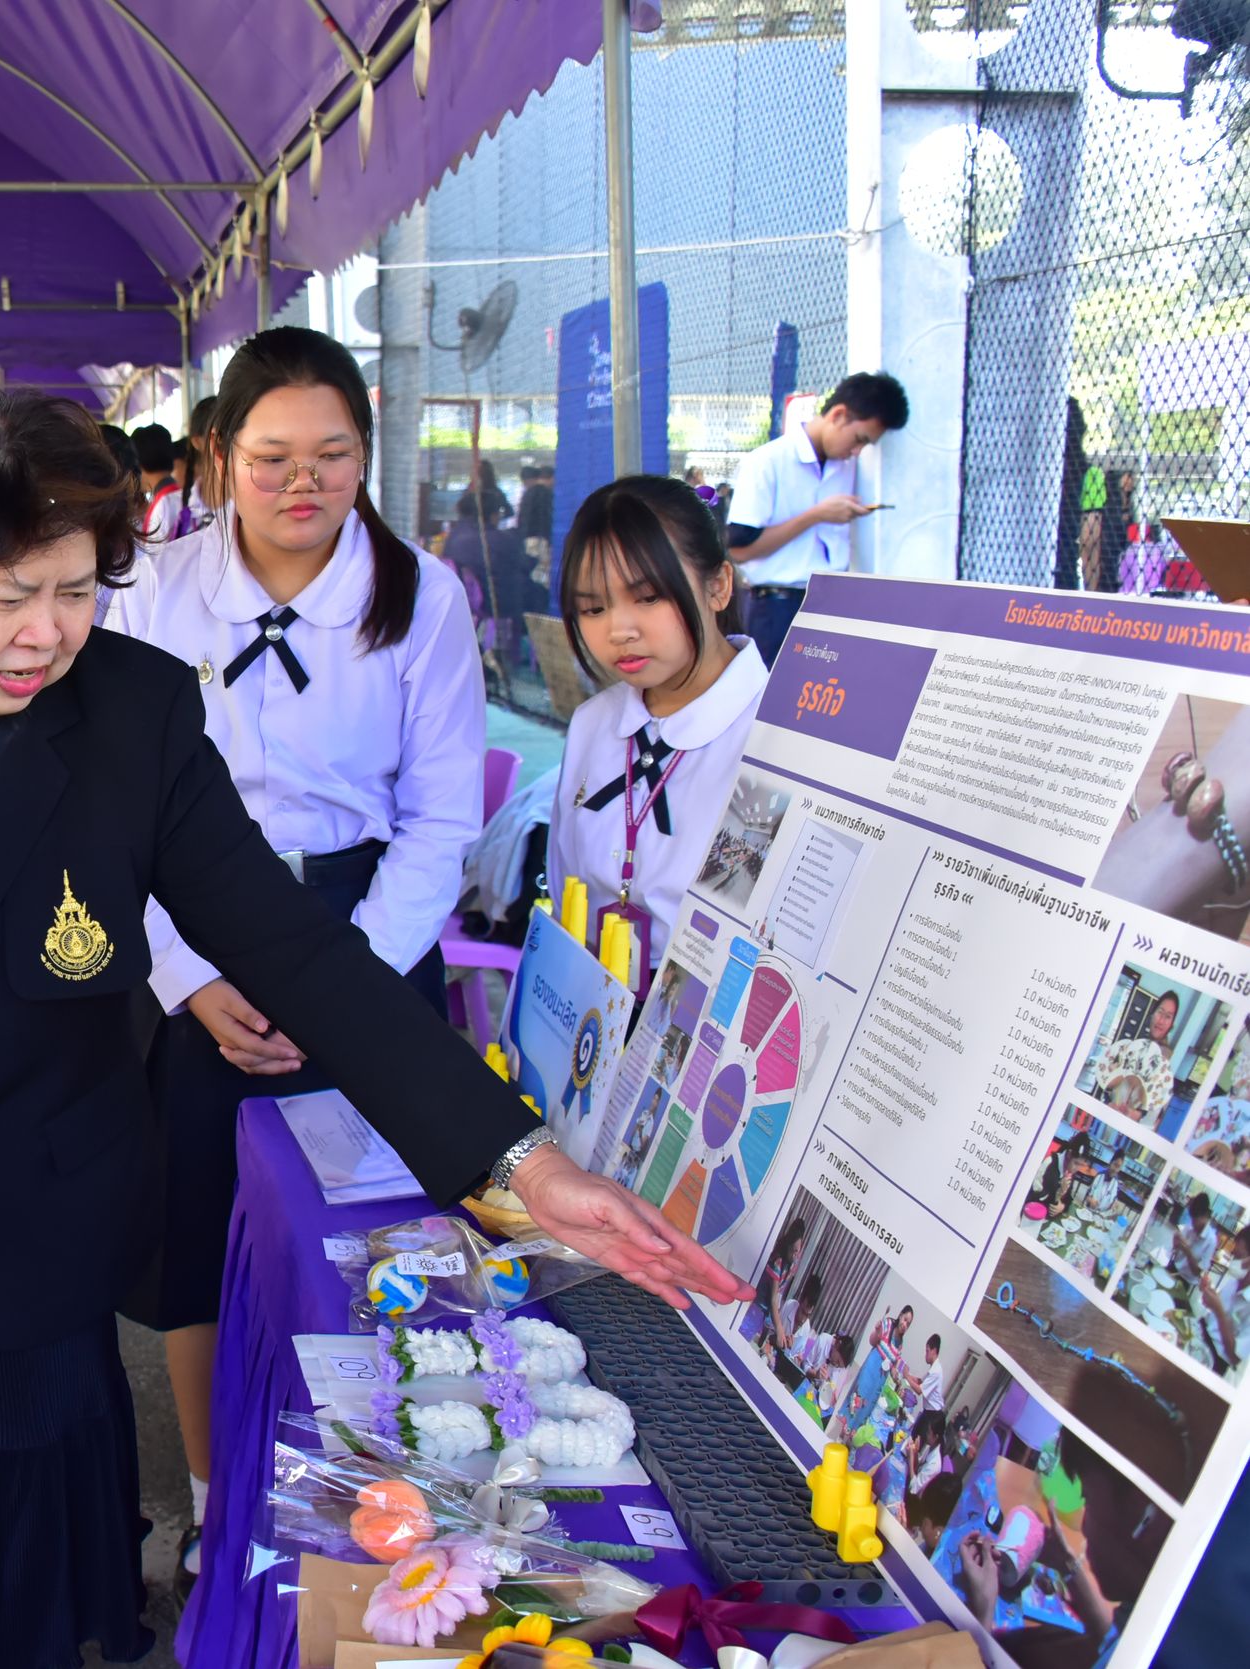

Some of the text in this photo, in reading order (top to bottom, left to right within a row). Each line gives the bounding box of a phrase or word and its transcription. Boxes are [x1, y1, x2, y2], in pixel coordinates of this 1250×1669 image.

[1004, 599, 1163, 641] โรงเรียนสาธิตนวัตกรรม
[797, 678, 846, 721] ธุรกิจ
[1055, 670, 1075, 683] (IDS
[1072, 672, 1142, 697] PRE-INNOVATOR)
[1140, 683, 1167, 702] ในกลุ่ม
[1097, 755, 1134, 773] สาขาธุรกิจ
[1060, 784, 1118, 809] รายวิชาการจัดการ
[814, 804, 886, 841] แนวทางการศึกษาต่อ
[933, 881, 959, 901] ธุรกิจ
[944, 856, 1110, 931] รายวิชาเพิ่มเติมกลุ่มพื้นฐานวิชาชีพ
[912, 913, 963, 944] การจัดการเบื้องต้น
[950, 950, 958, 962] 1
[943, 967, 951, 980] 2
[1030, 968, 1077, 998] 1.0 หน่วยกิต
[532, 974, 578, 1034] รองชนะเลิศ
[1022, 987, 1070, 1018] 1.0 หน่วยกิต
[1015, 1006, 1062, 1038] 1.0 หน่วยกิต
[921, 1042, 929, 1055] 1
[1007, 1025, 1054, 1058] 1.0 หน่วยกิต
[913, 1060, 922, 1072] 2
[999, 1045, 1046, 1078] 1.0 หน่วยกิต
[992, 1063, 1038, 1097] 1.0 หน่วยกิต
[984, 1082, 1030, 1117] 1.0 หน่วยกิต
[977, 1101, 1021, 1136] 1.0 หน่วยกิต
[970, 1120, 1013, 1155] 1.0 หน่วยกิต
[826, 1150, 869, 1195] ภาพกิจกรรม
[962, 1138, 1004, 1174] 1.0 หน่วยกิต
[954, 1157, 995, 1193] 1.0 หน่วยกิต
[946, 1176, 987, 1212] 1.0 หน่วยกิต
[817, 1172, 904, 1255] การจัดการเรียนการสอน
[631, 1513, 675, 1539] 69
